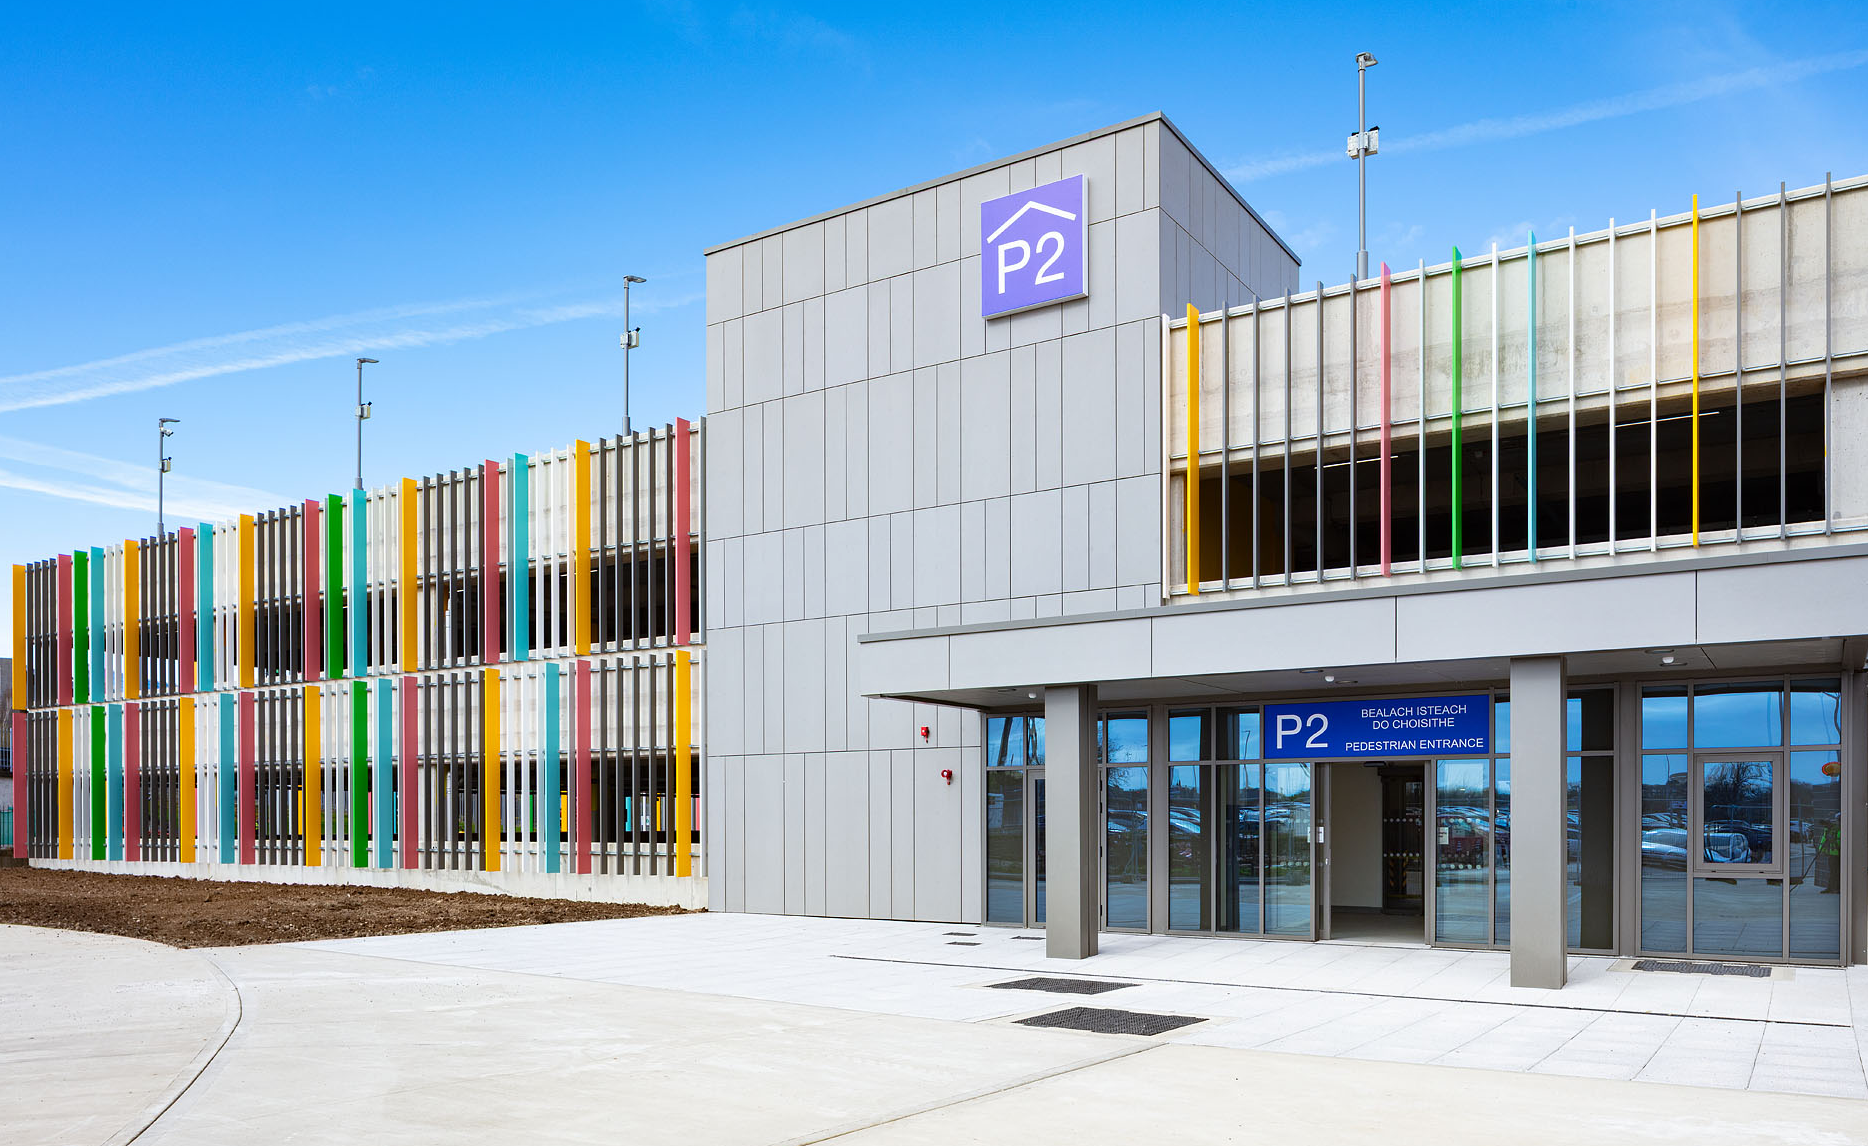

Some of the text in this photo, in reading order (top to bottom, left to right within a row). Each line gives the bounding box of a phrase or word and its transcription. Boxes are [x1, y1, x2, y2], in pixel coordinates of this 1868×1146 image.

[997, 231, 1065, 295] P2
[1361, 704, 1467, 718] BEALACH ISTEACH
[1372, 717, 1455, 730] DO CHOISITHE
[1276, 713, 1329, 750] P2
[1345, 737, 1484, 751] PEDESTRIAN ENTRANCE
